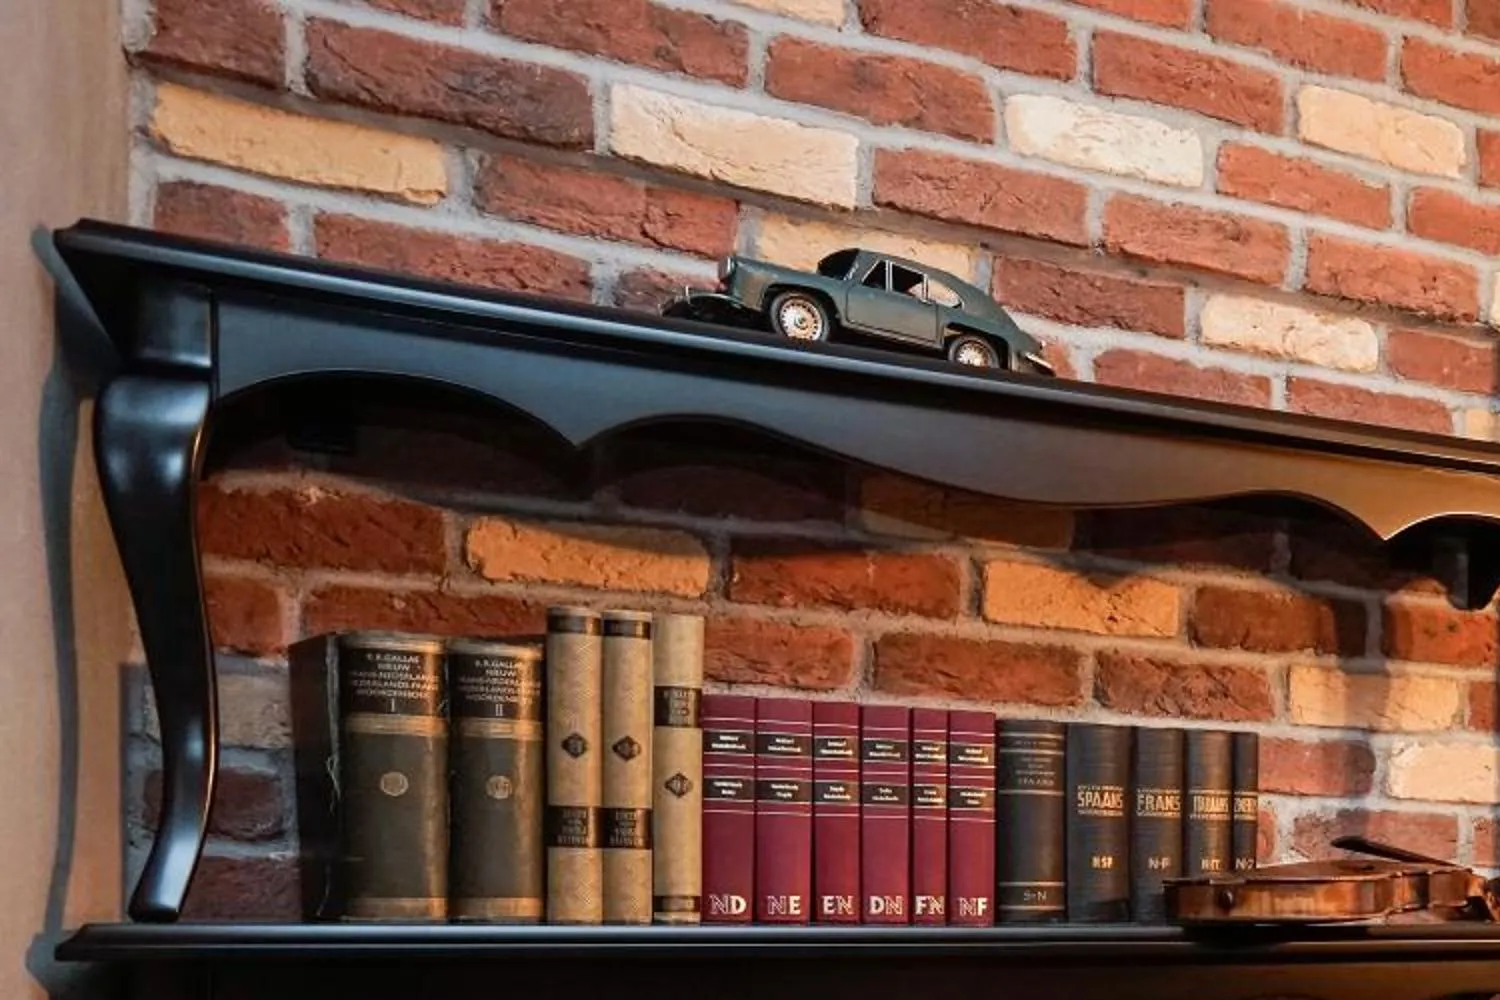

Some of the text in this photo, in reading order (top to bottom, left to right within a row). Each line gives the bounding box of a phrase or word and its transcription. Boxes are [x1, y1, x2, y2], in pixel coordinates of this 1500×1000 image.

[1077, 791, 1123, 808] SPAANS
[1137, 793, 1180, 811] FRANS
[710, 894, 747, 915] ND
[767, 895, 801, 915] NE
[822, 895, 854, 915] EN
[869, 895, 904, 915] DN
[915, 895, 945, 915] FN
[959, 897, 988, 916] NF
